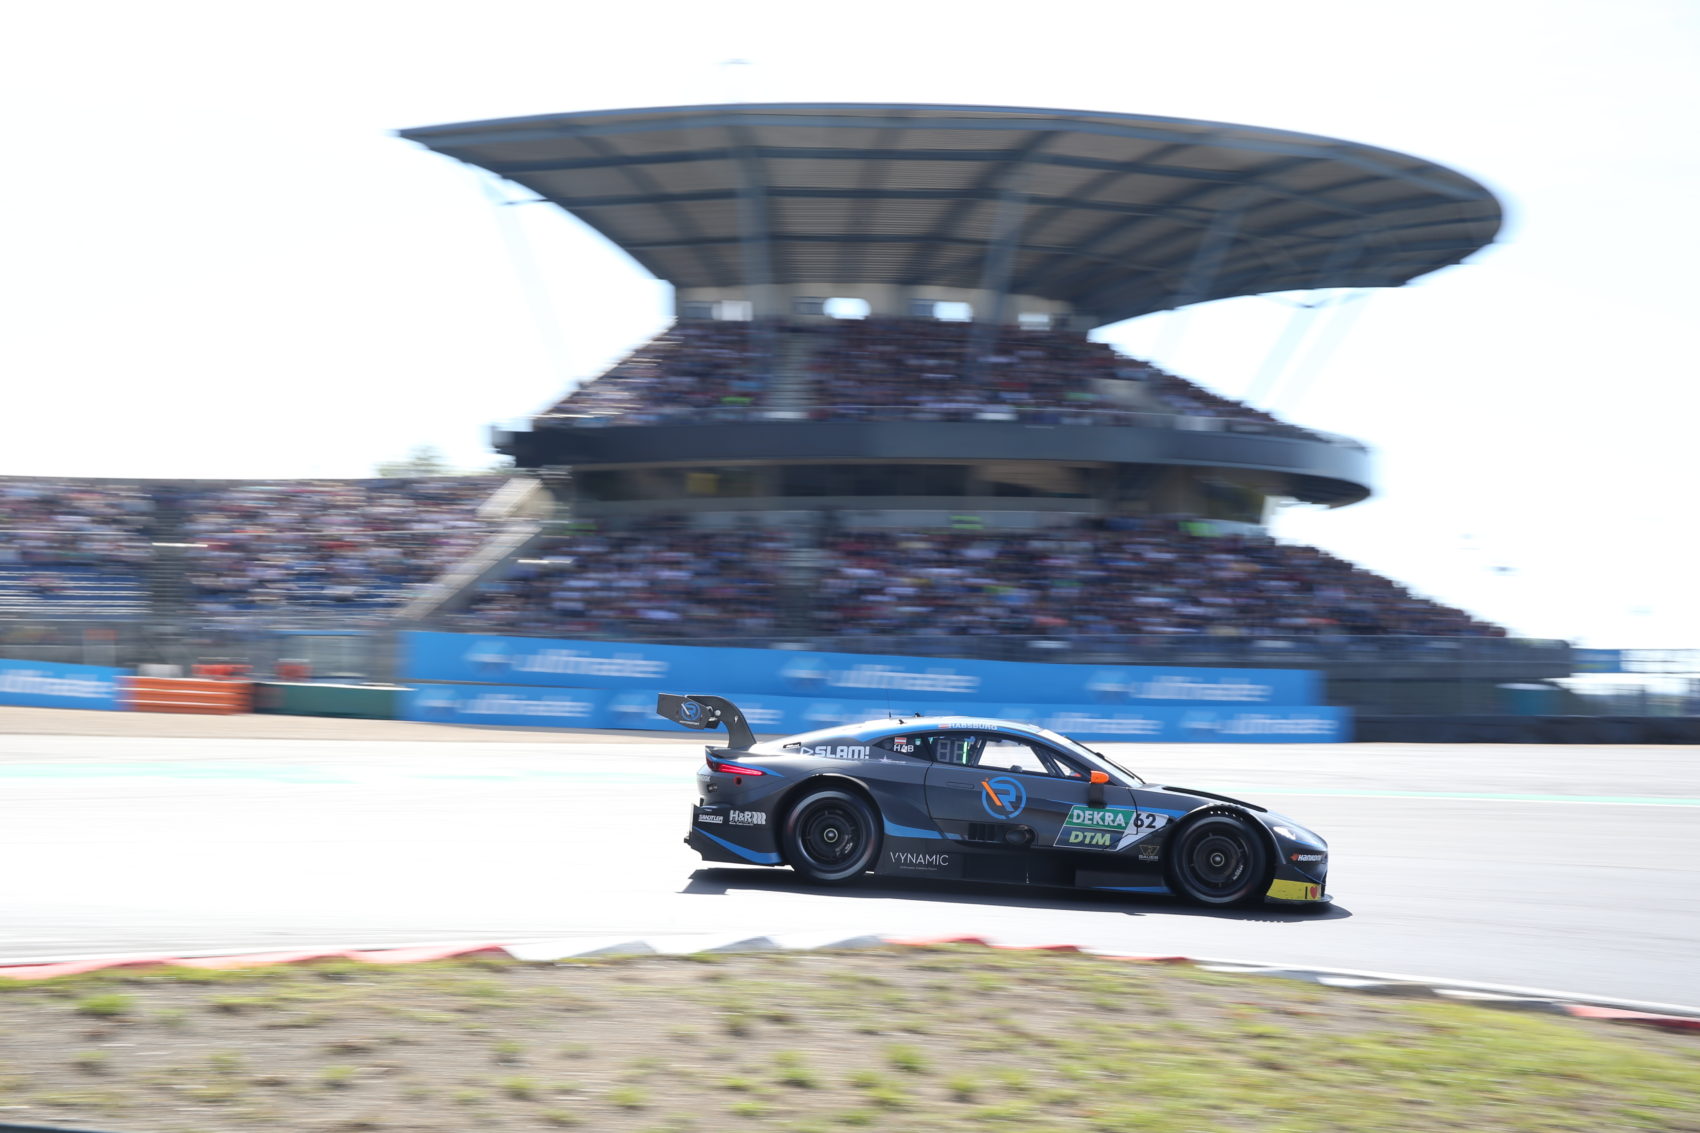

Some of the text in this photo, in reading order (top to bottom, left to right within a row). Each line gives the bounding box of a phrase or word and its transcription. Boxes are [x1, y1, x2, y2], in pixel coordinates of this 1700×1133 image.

[814, 745, 870, 759] SLAM!
[1072, 809, 1126, 827] DEKRA
[1133, 813, 1157, 829] 62
[1069, 831, 1111, 846] DTM
[890, 851, 949, 866] VYNAMIC
